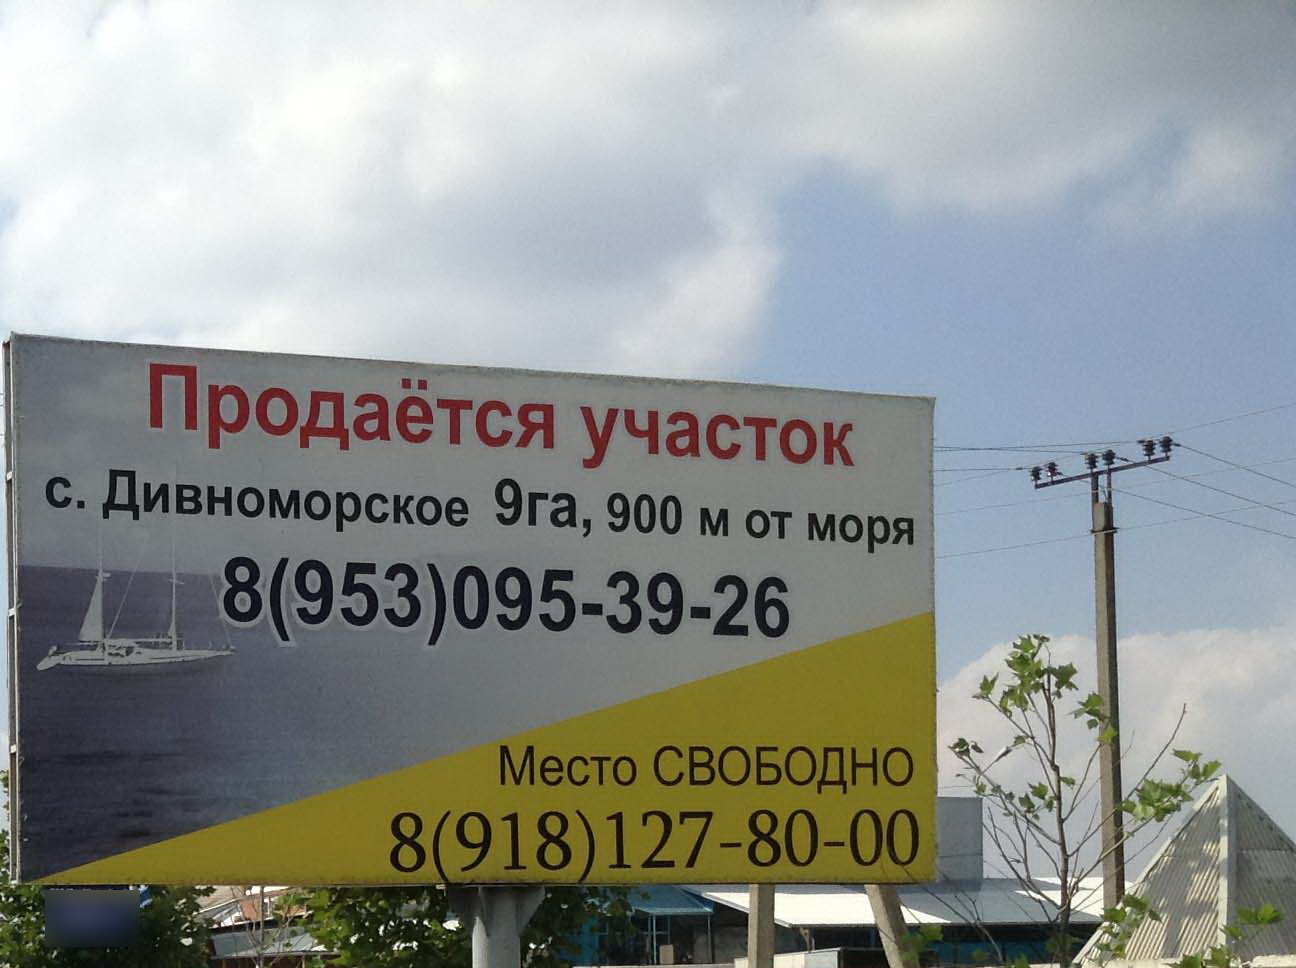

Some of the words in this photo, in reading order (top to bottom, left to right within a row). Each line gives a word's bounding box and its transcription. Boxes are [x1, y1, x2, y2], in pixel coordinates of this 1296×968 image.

[149, 362, 555, 451] Продаётся
[579, 405, 855, 469] участок
[45, 475, 86, 509] с.
[102, 468, 470, 532] Дивноморское
[494, 477, 592, 538] 9га,
[606, 492, 683, 535] 900
[699, 507, 729, 537] м
[745, 509, 793, 539] от
[807, 512, 915, 554] моря
[222, 556, 790, 646] 8(953)095-39-26
[498, 744, 638, 787] Место
[652, 744, 915, 795] СВОБОДНО
[388, 808, 921, 883] 8(918)127-80-00
